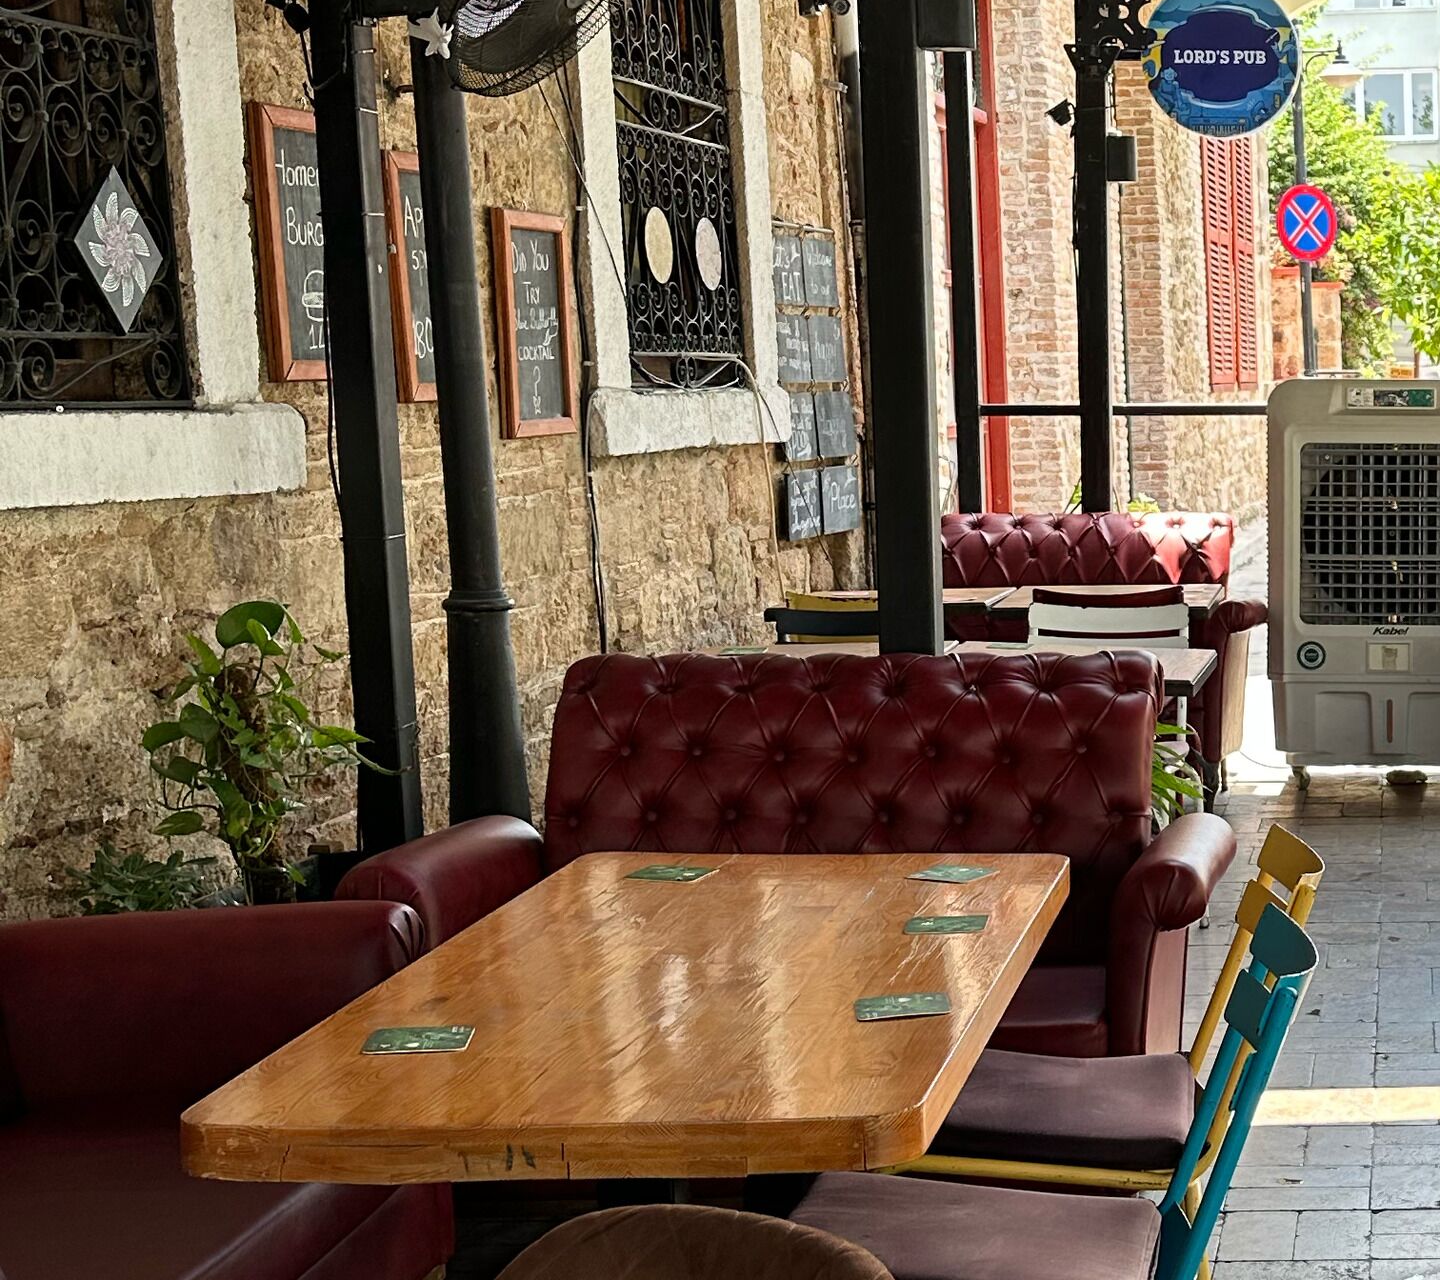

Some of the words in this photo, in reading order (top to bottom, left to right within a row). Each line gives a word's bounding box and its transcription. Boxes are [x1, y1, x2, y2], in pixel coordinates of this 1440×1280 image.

[1173, 49, 1230, 64] LORD'S
[1233, 50, 1266, 64] PUB
[782, 272, 802, 301] EAT
[518, 345, 555, 361] COCKTAIL
[1373, 626, 1409, 635] Kabel
